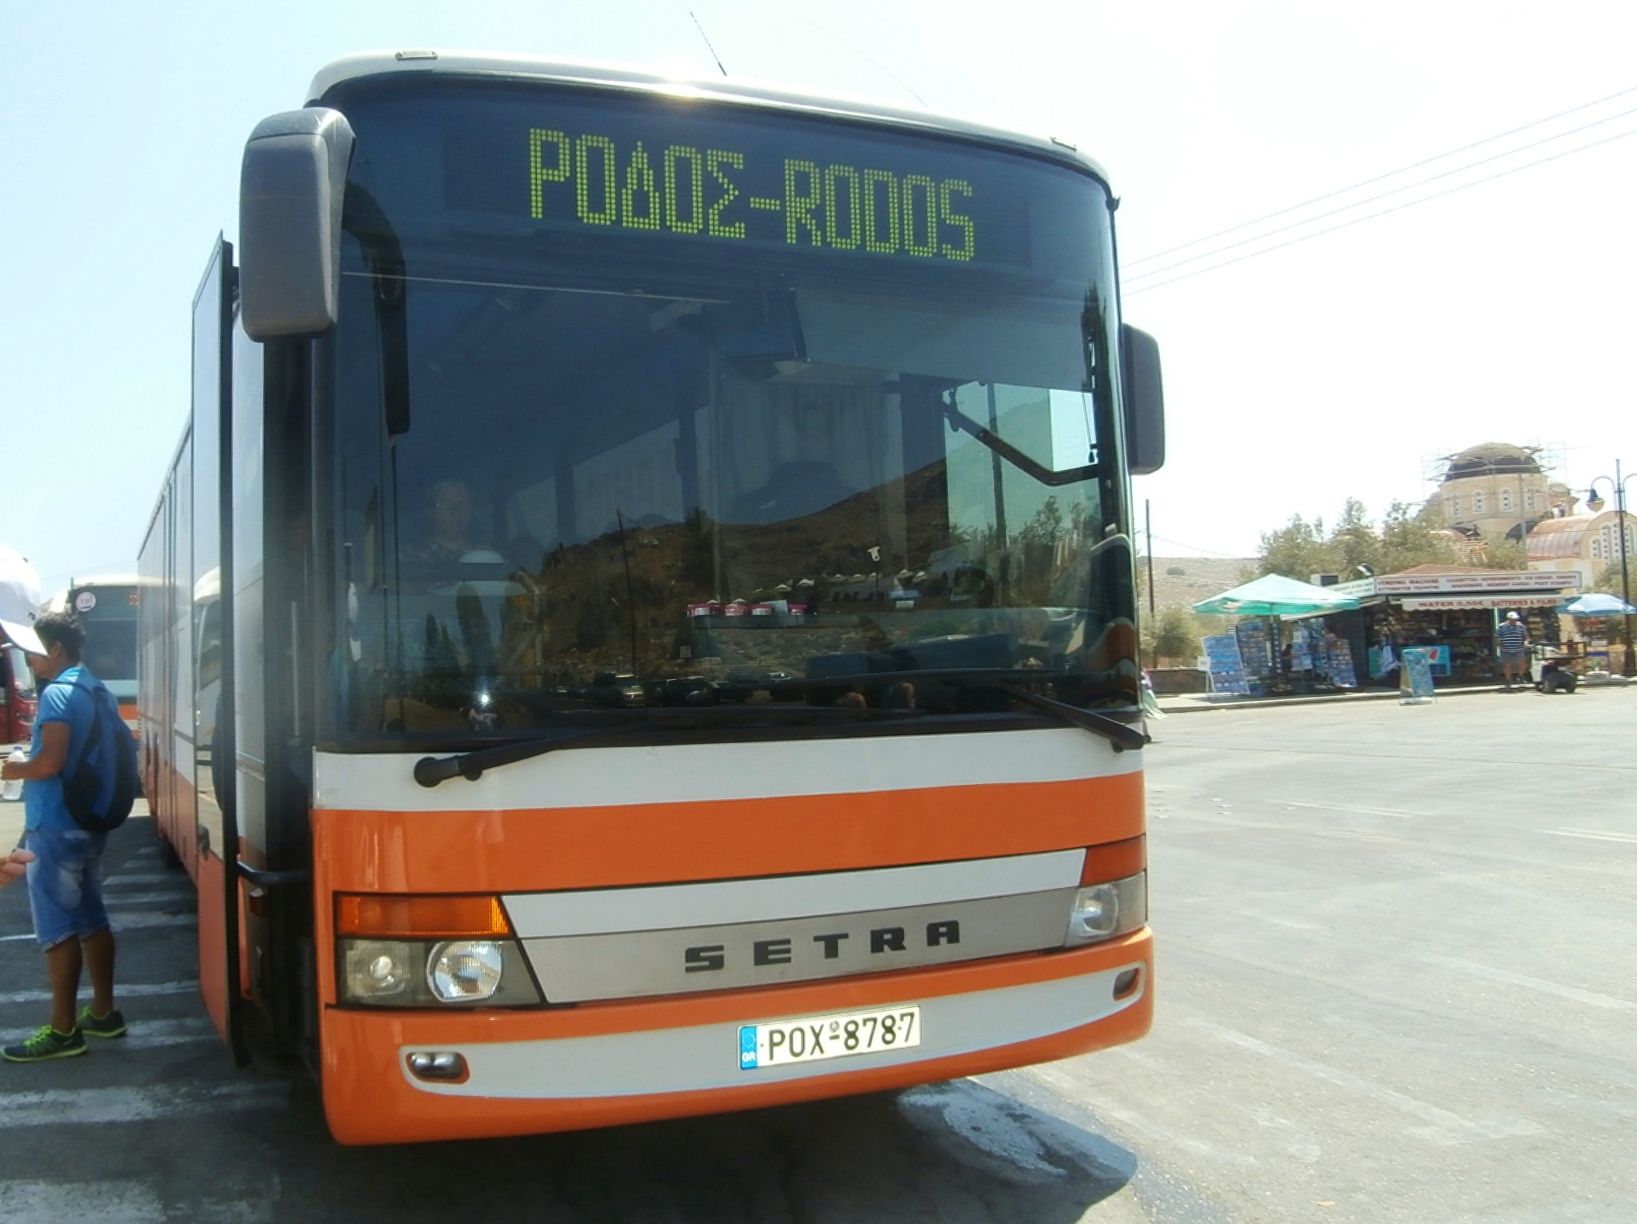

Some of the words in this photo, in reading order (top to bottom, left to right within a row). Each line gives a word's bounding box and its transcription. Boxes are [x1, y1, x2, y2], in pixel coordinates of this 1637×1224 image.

[1491, 599, 1528, 607] BATTERIES
[685, 919, 960, 974] SETRA
[741, 1051, 757, 1063] GR
